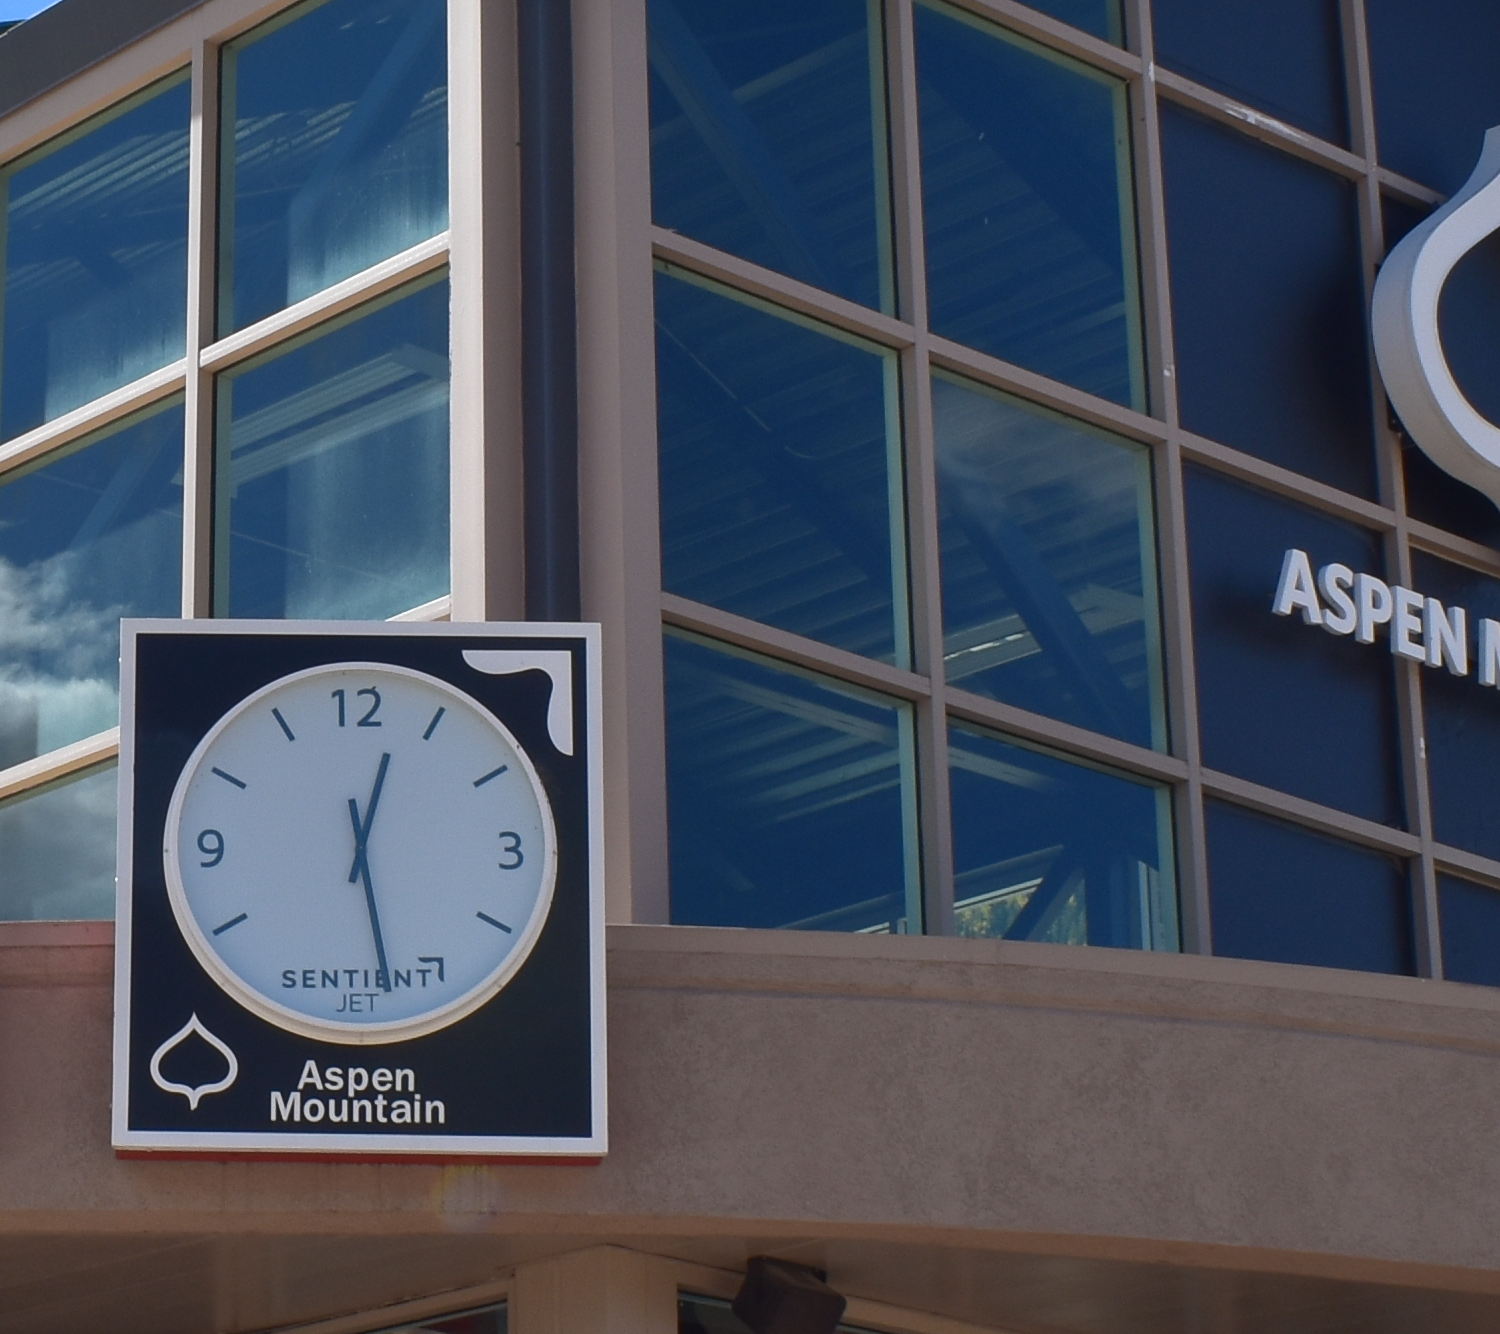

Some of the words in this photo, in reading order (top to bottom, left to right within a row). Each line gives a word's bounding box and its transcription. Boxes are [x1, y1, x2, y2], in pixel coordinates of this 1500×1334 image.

[1271, 548, 1468, 677] ASPEN
[331, 687, 382, 728] 12
[196, 828, 225, 868] 9
[497, 830, 525, 871] 3
[281, 969, 433, 989] SENTIENT
[335, 992, 380, 1013] JET
[297, 1058, 416, 1098] Aspen
[269, 1090, 446, 1124] Mountain
